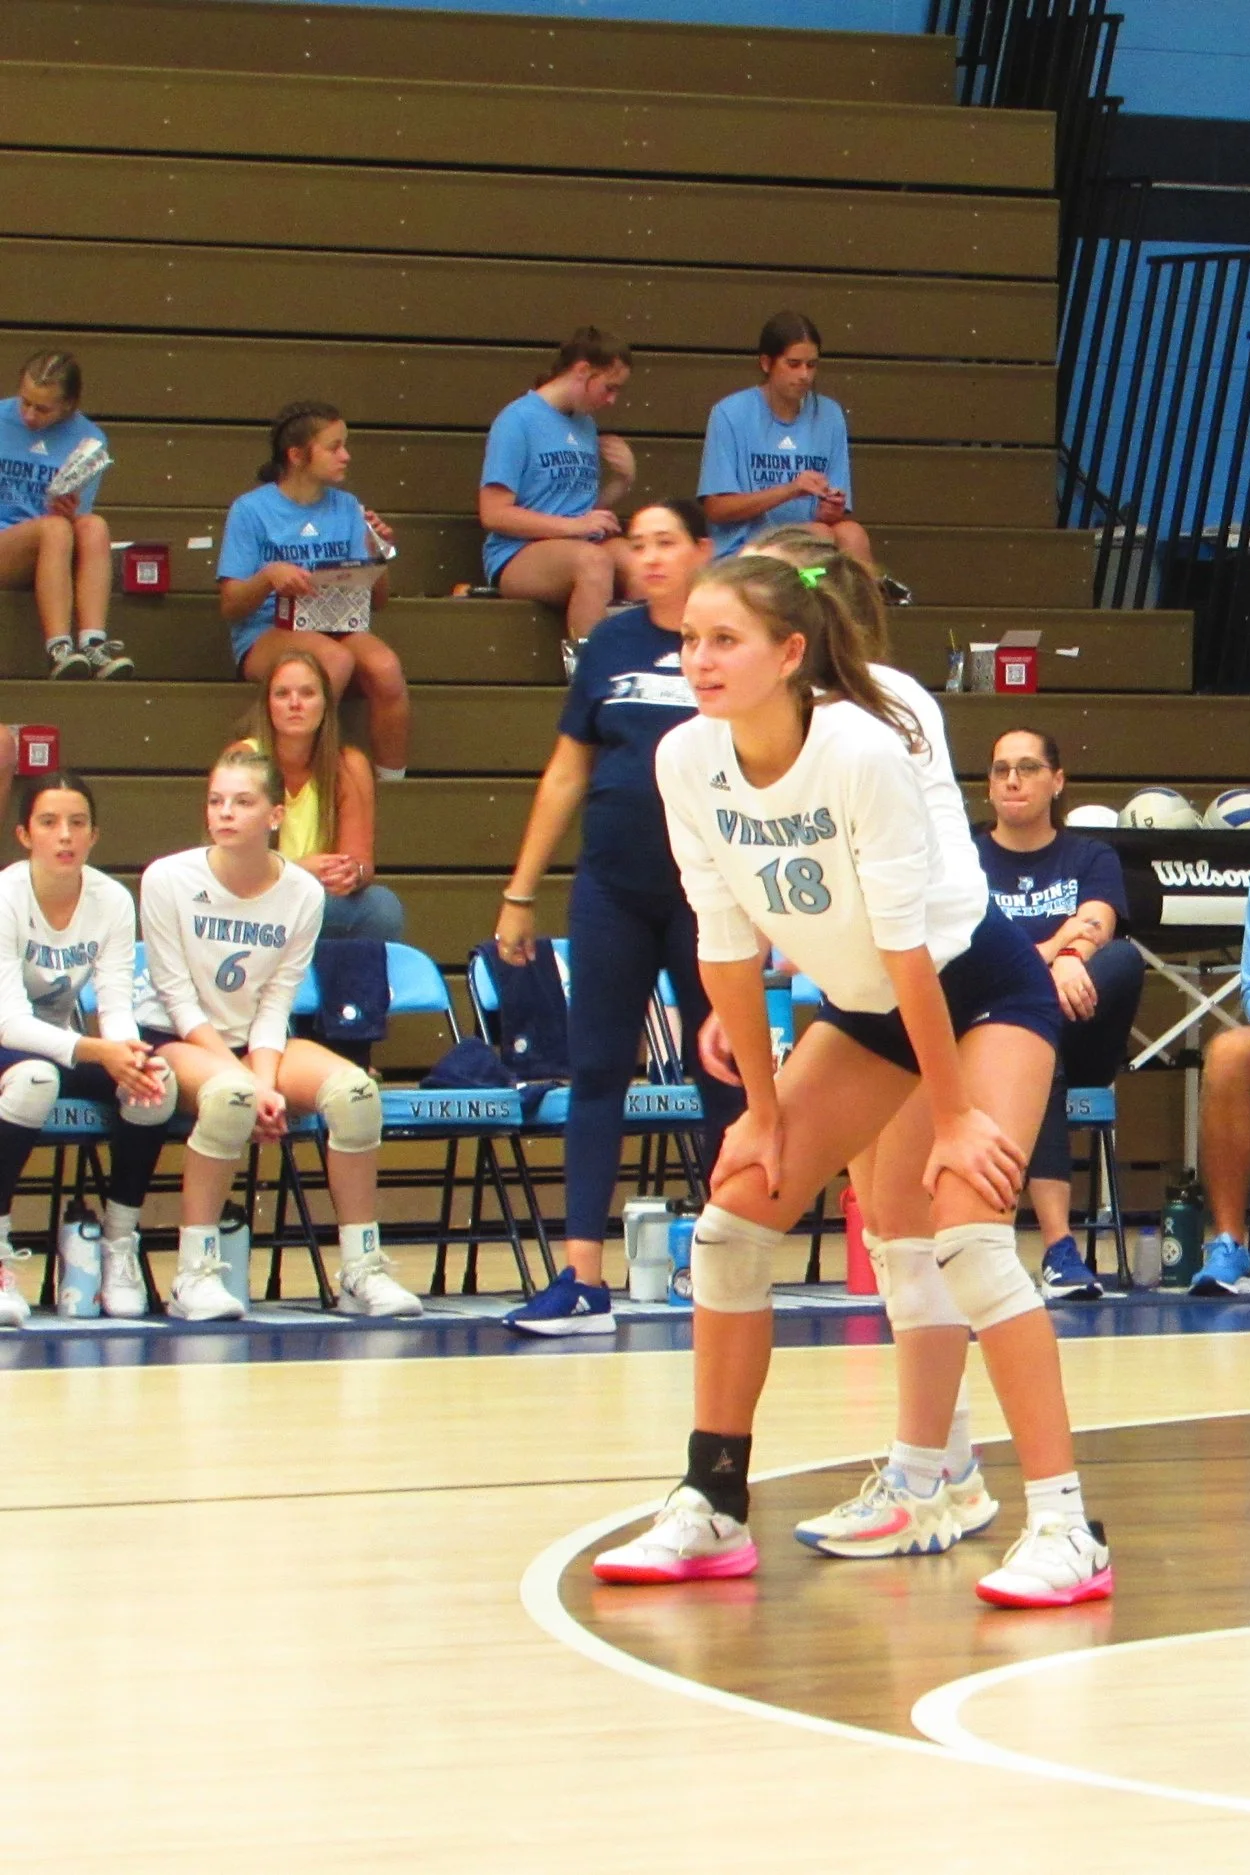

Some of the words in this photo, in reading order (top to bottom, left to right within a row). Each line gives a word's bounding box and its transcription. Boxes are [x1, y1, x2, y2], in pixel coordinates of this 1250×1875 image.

[262, 543, 310, 562] UNION
[716, 807, 837, 848] VIKINGS
[754, 857, 832, 915] 18
[994, 893, 1026, 907] ION
[194, 915, 287, 949] VIKINGS
[215, 950, 251, 993] 6
[409, 1100, 511, 1119] VIKINGS
[626, 1094, 700, 1113] KINGS
